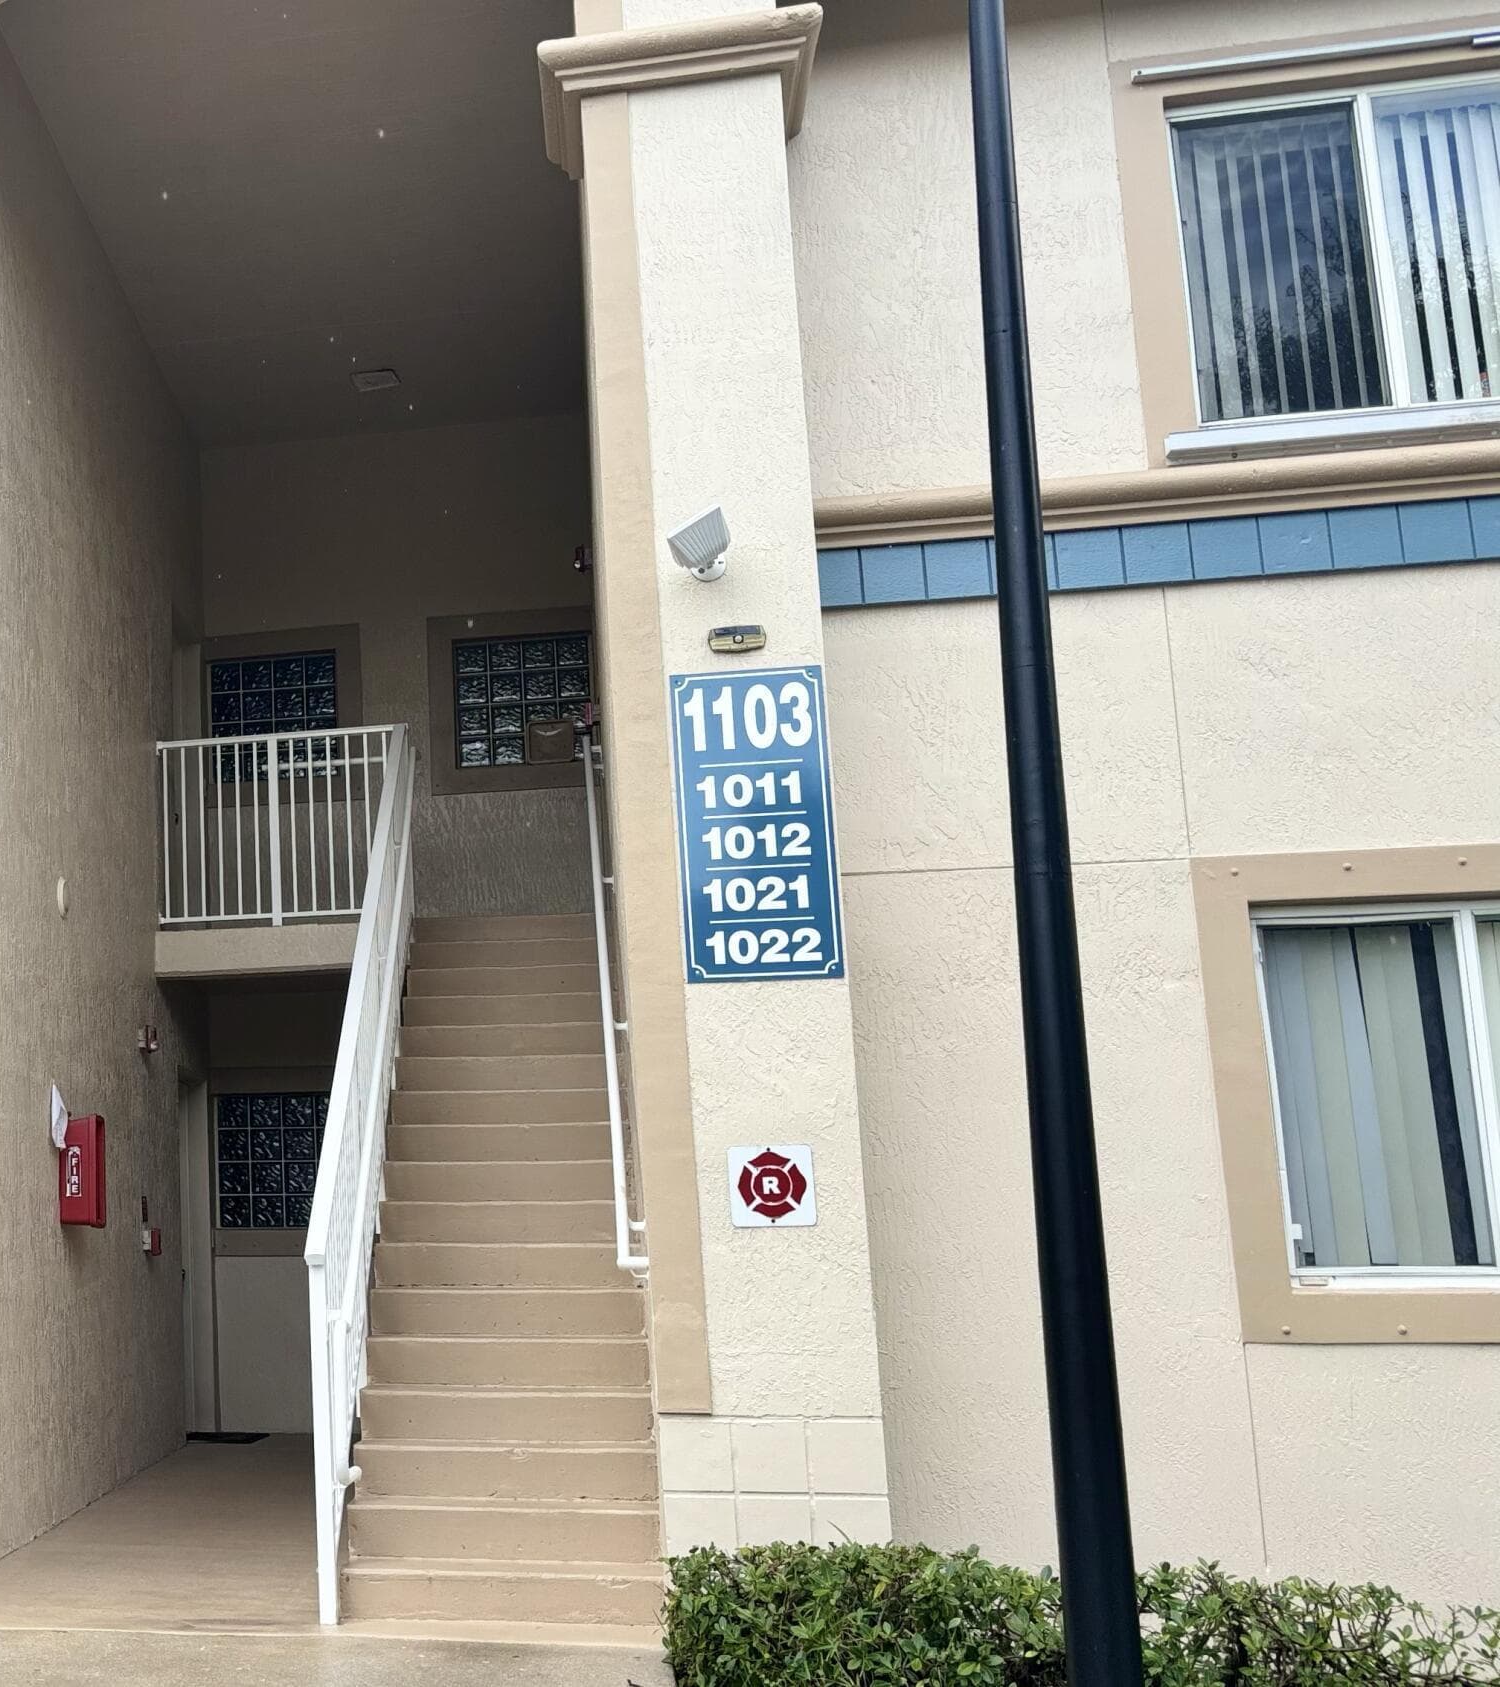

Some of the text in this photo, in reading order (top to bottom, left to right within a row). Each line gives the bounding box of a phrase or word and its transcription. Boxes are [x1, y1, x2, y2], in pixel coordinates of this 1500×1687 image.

[683, 682, 813, 752] 1103
[696, 770, 802, 808] 1011
[702, 823, 812, 860] 1012
[703, 875, 810, 912] 1021
[706, 927, 823, 965] 1022
[71, 1157, 79, 1193] FIRE
[762, 1176, 781, 1195] R
